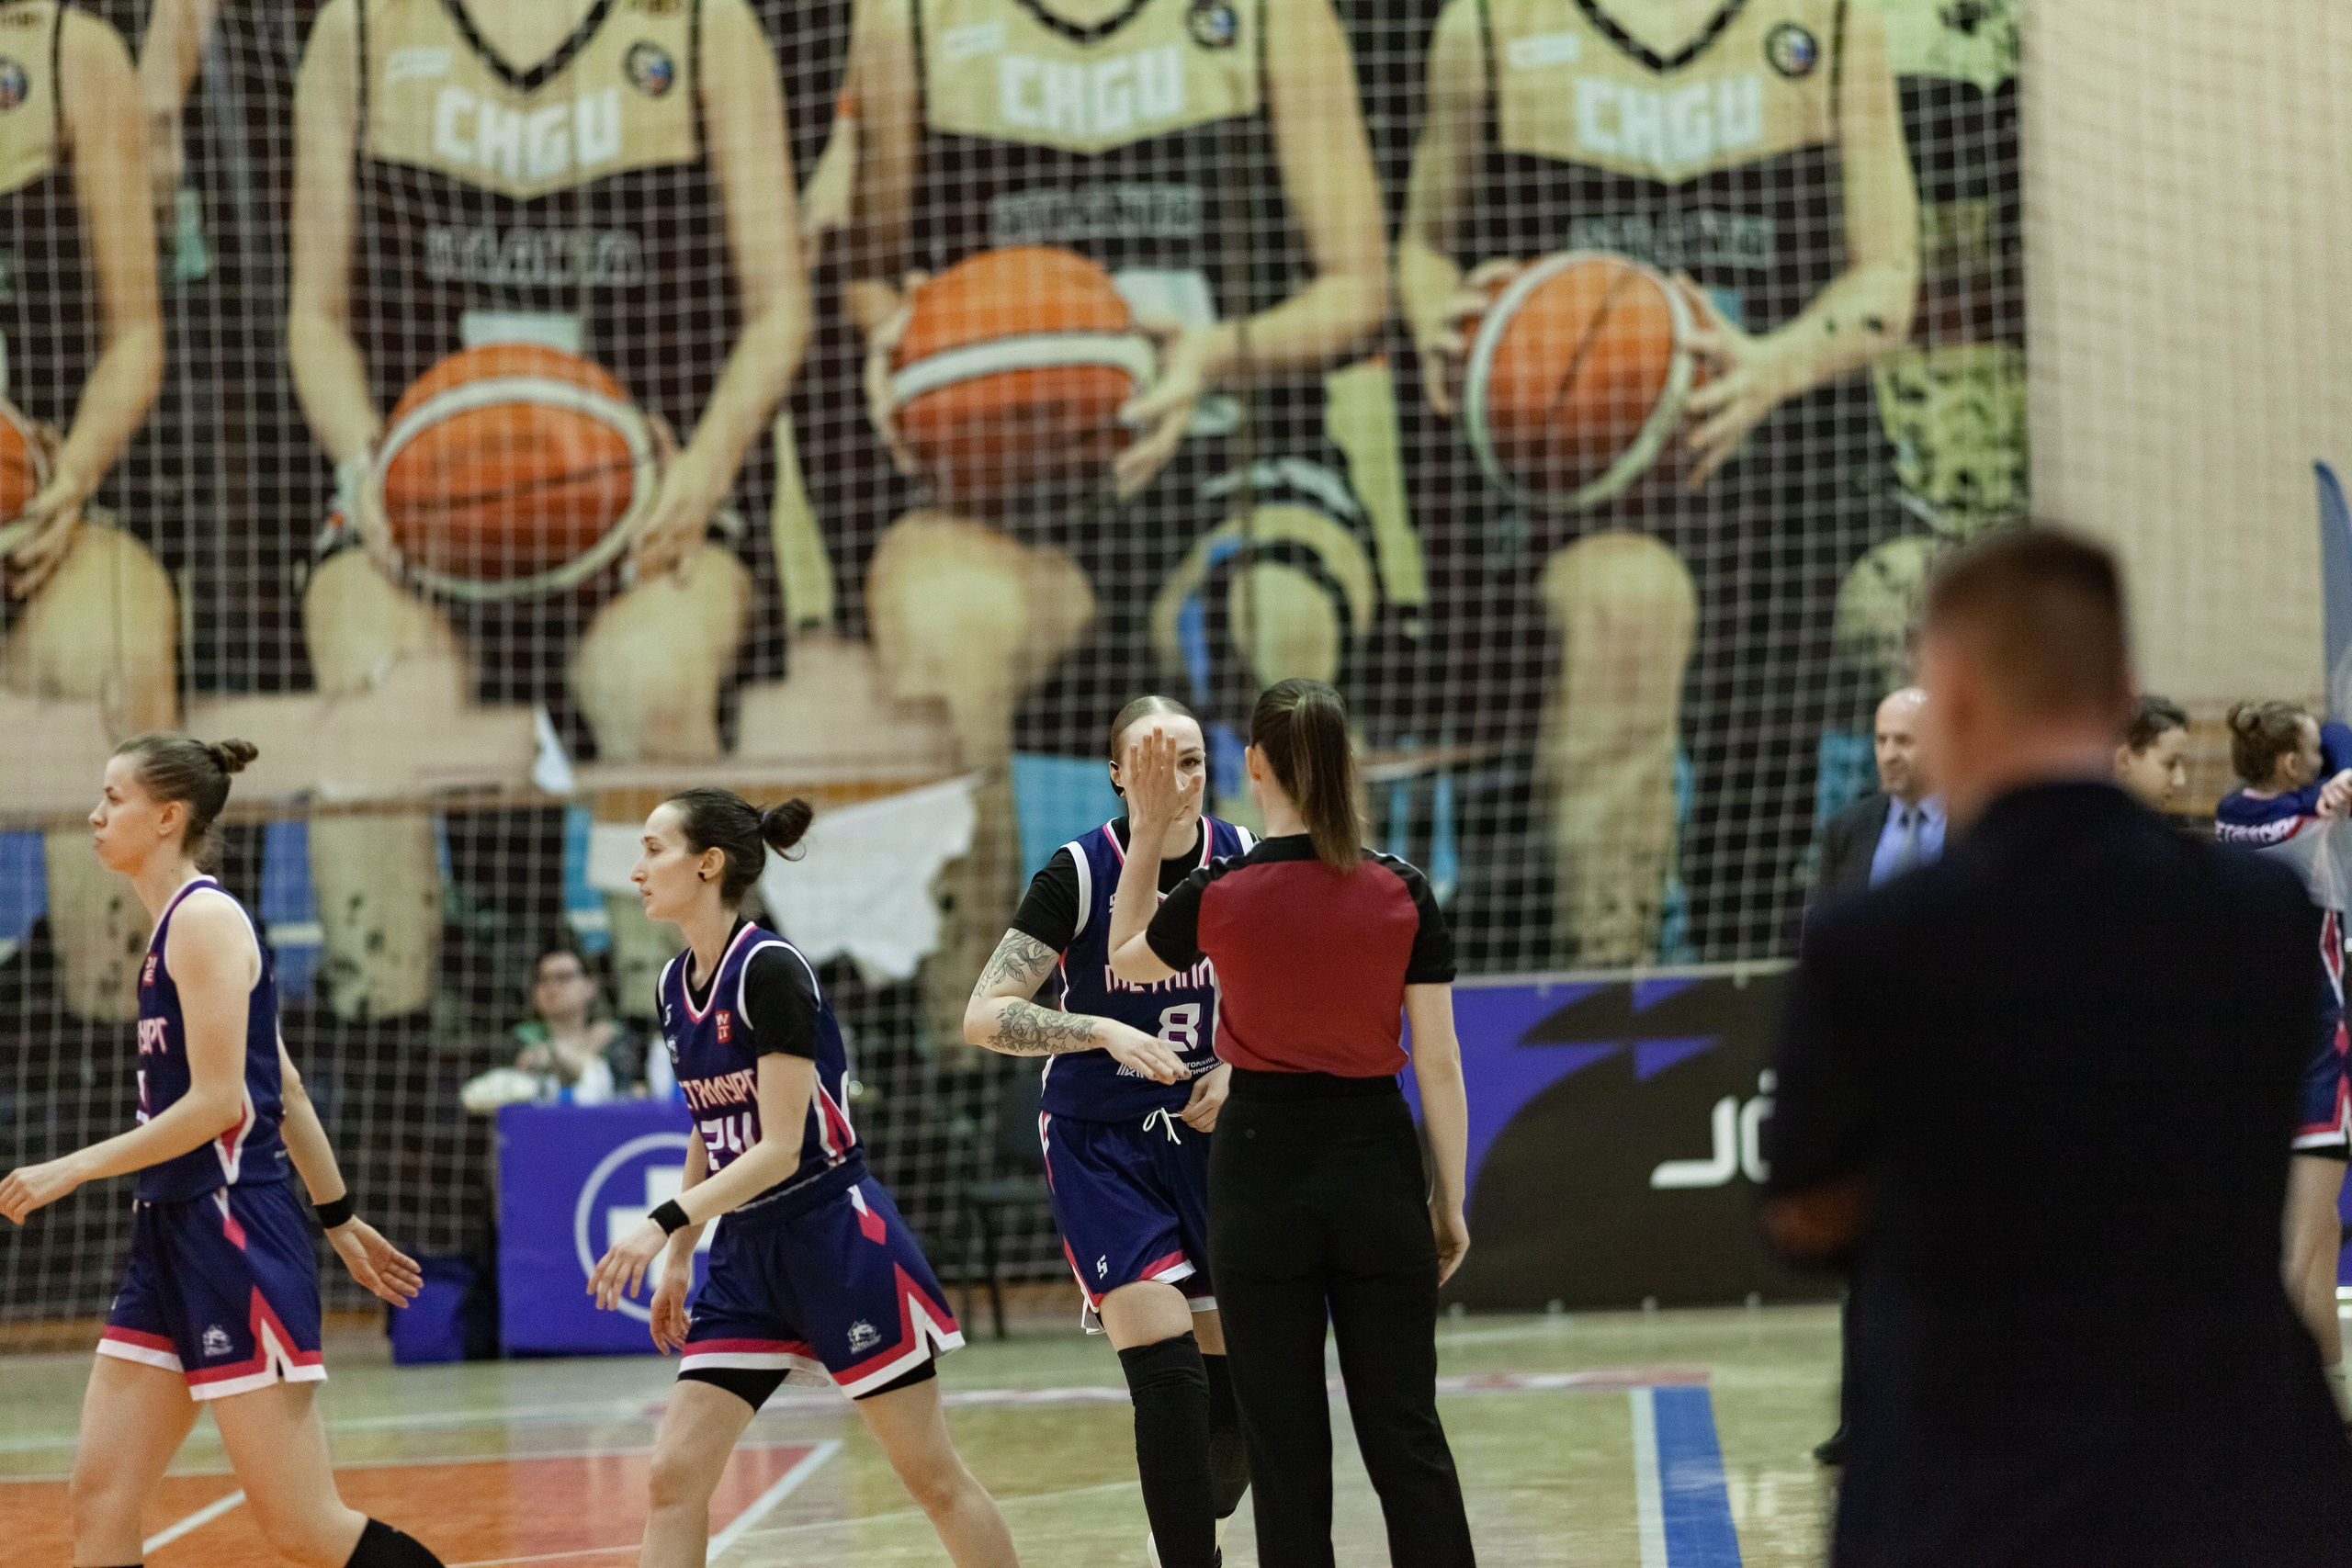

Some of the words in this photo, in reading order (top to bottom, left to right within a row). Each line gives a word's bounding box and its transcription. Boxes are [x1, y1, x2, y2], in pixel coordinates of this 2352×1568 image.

[435, 83, 621, 179] CHGU
[1001, 45, 1183, 136] CHGU
[1576, 72, 1762, 164] CHGU
[1158, 1003, 1203, 1053] 8
